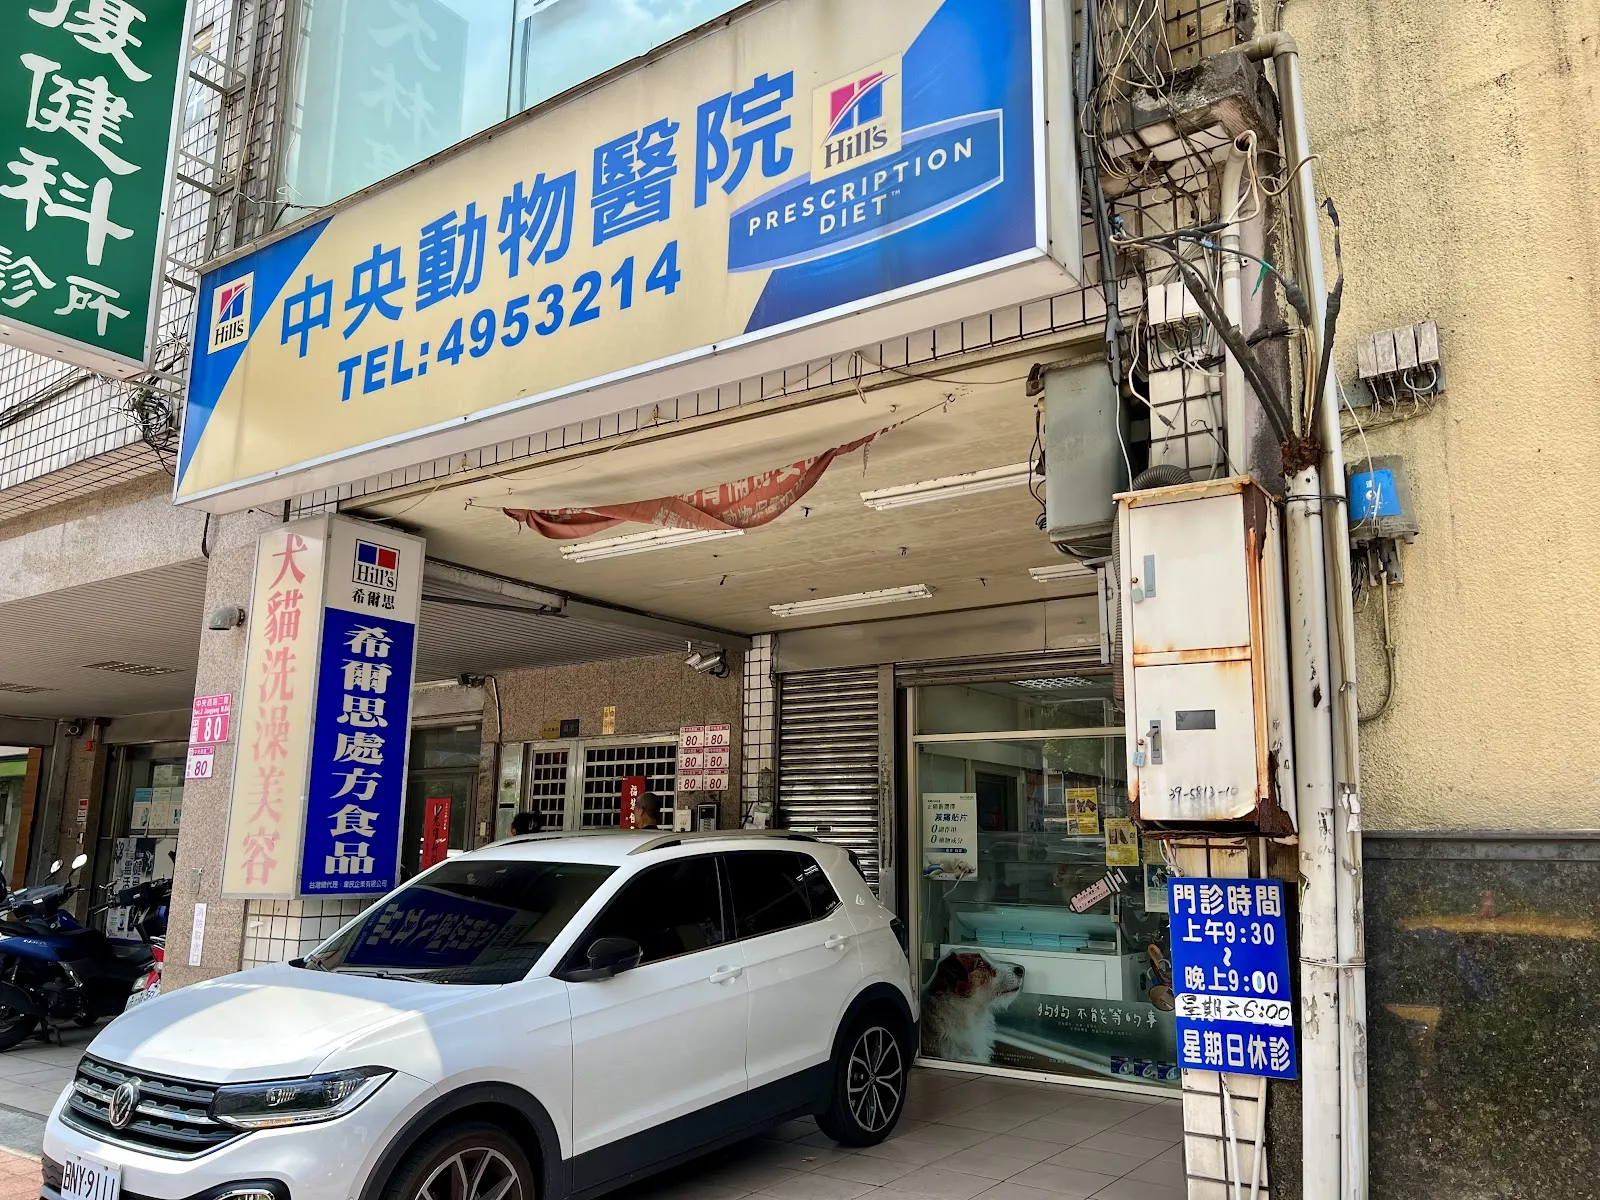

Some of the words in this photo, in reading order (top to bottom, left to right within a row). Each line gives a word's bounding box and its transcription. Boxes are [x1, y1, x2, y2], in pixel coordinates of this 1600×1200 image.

[824, 125, 888, 169] Hill's
[749, 138, 972, 237] PRESCRIPTION
[280, 70, 794, 358] 中央動物醫院
[820, 193, 887, 235] DIET
[214, 321, 244, 346] Hill's
[357, 564, 394, 588] Hill's
[352, 587, 395, 609] 希爾思
[240, 533, 308, 886] 犬貓洗澡美容
[204, 716, 222, 741] 80
[685, 735, 698, 746] 80
[711, 734, 723, 745] 80
[324, 624, 394, 875] 希爾思處方食品
[685, 757, 697, 767] 80
[710, 756, 722, 767] 80
[194, 760, 208, 776] 80
[684, 778, 696, 789] 80
[709, 778, 722, 789] 80
[1173, 884, 1281, 917] 門診時間
[1182, 918, 1275, 945] 上午9:30
[1184, 965, 1279, 994] 晚上9:00
[1038, 1003, 1070, 1019] 狗狗
[1077, 1007, 1157, 1028] 不能等的事
[1182, 994, 1290, 1020] 星期六6:00
[1183, 1029, 1291, 1072] 星期日休診
